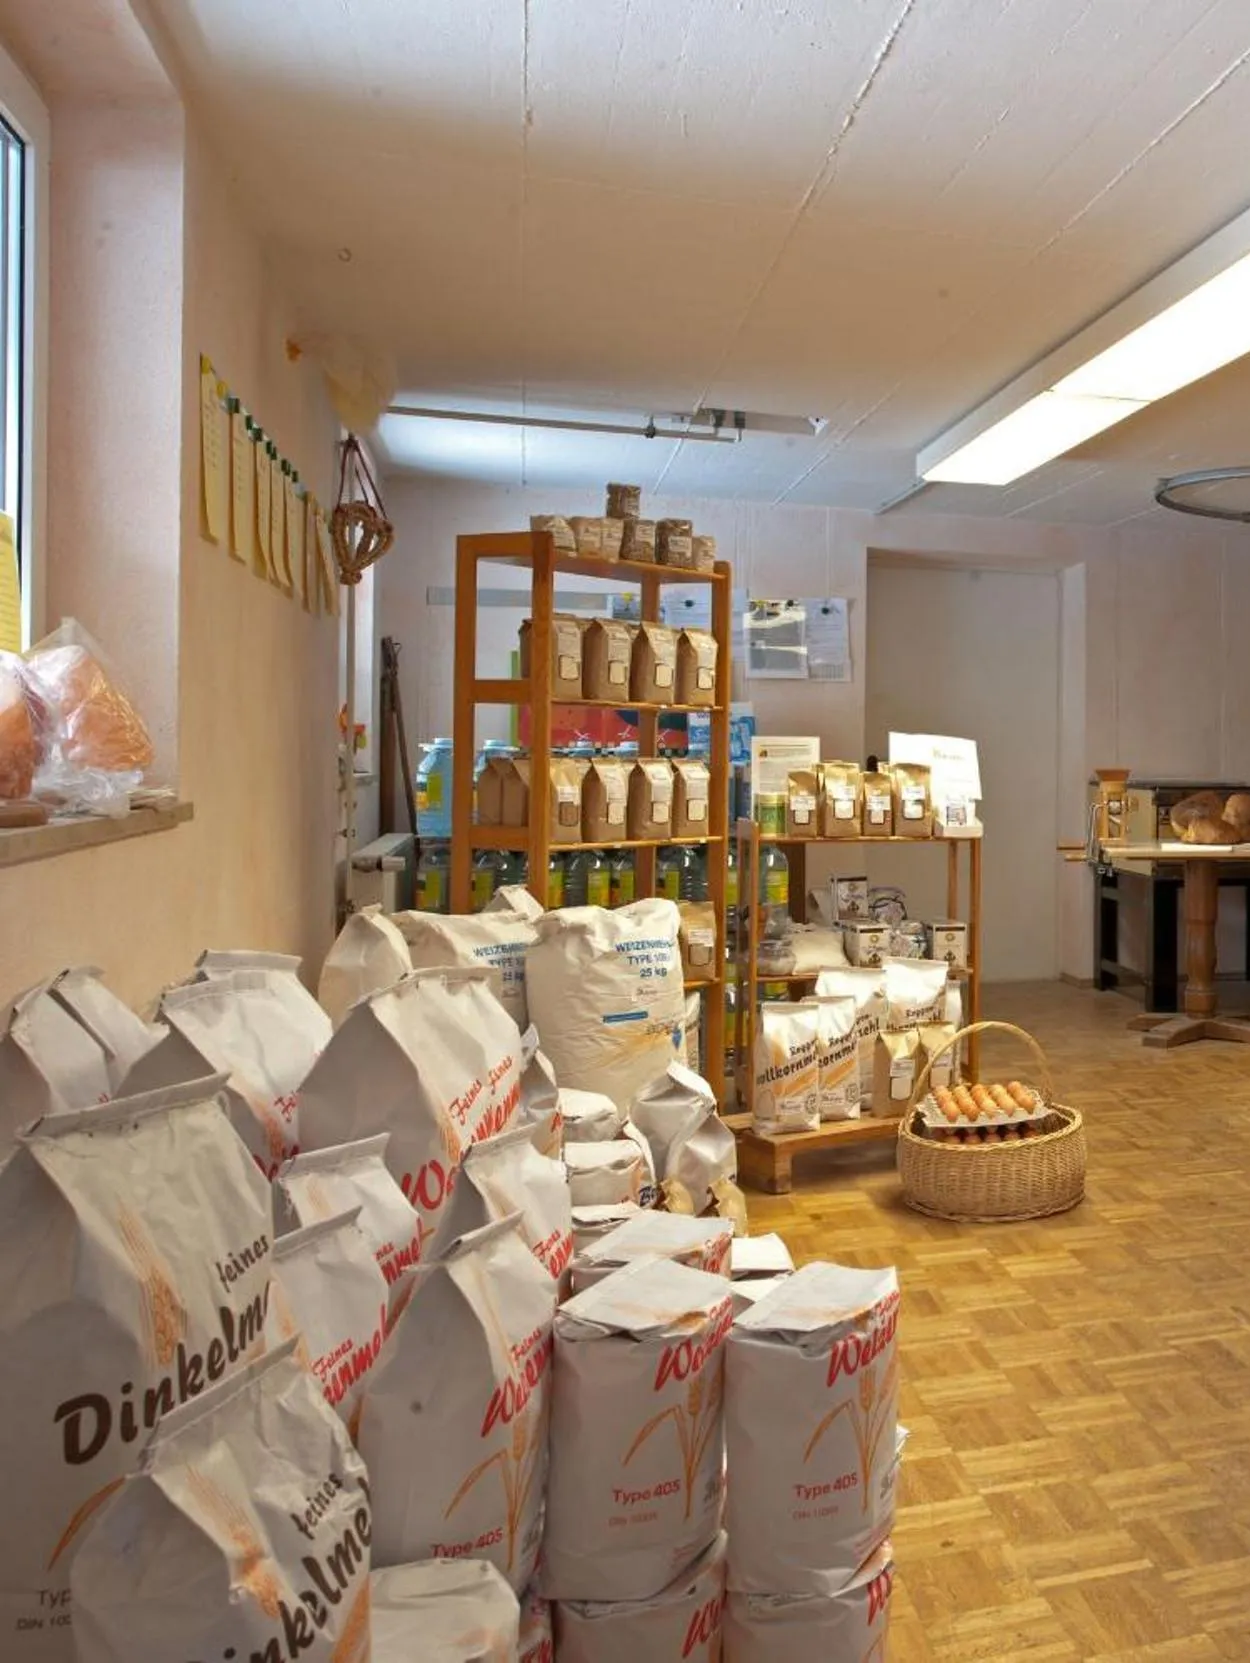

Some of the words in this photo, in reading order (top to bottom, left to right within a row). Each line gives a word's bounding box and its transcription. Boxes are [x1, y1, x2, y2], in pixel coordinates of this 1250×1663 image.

[640, 967, 652, 978] 25
[216, 1234, 270, 1293] feines
[613, 1488, 651, 1506] Type
[653, 1479, 680, 1497] 405
[794, 1483, 831, 1500] Type
[833, 1472, 858, 1491] 405
[431, 1541, 473, 1558] Type
[475, 1527, 504, 1549] 405
